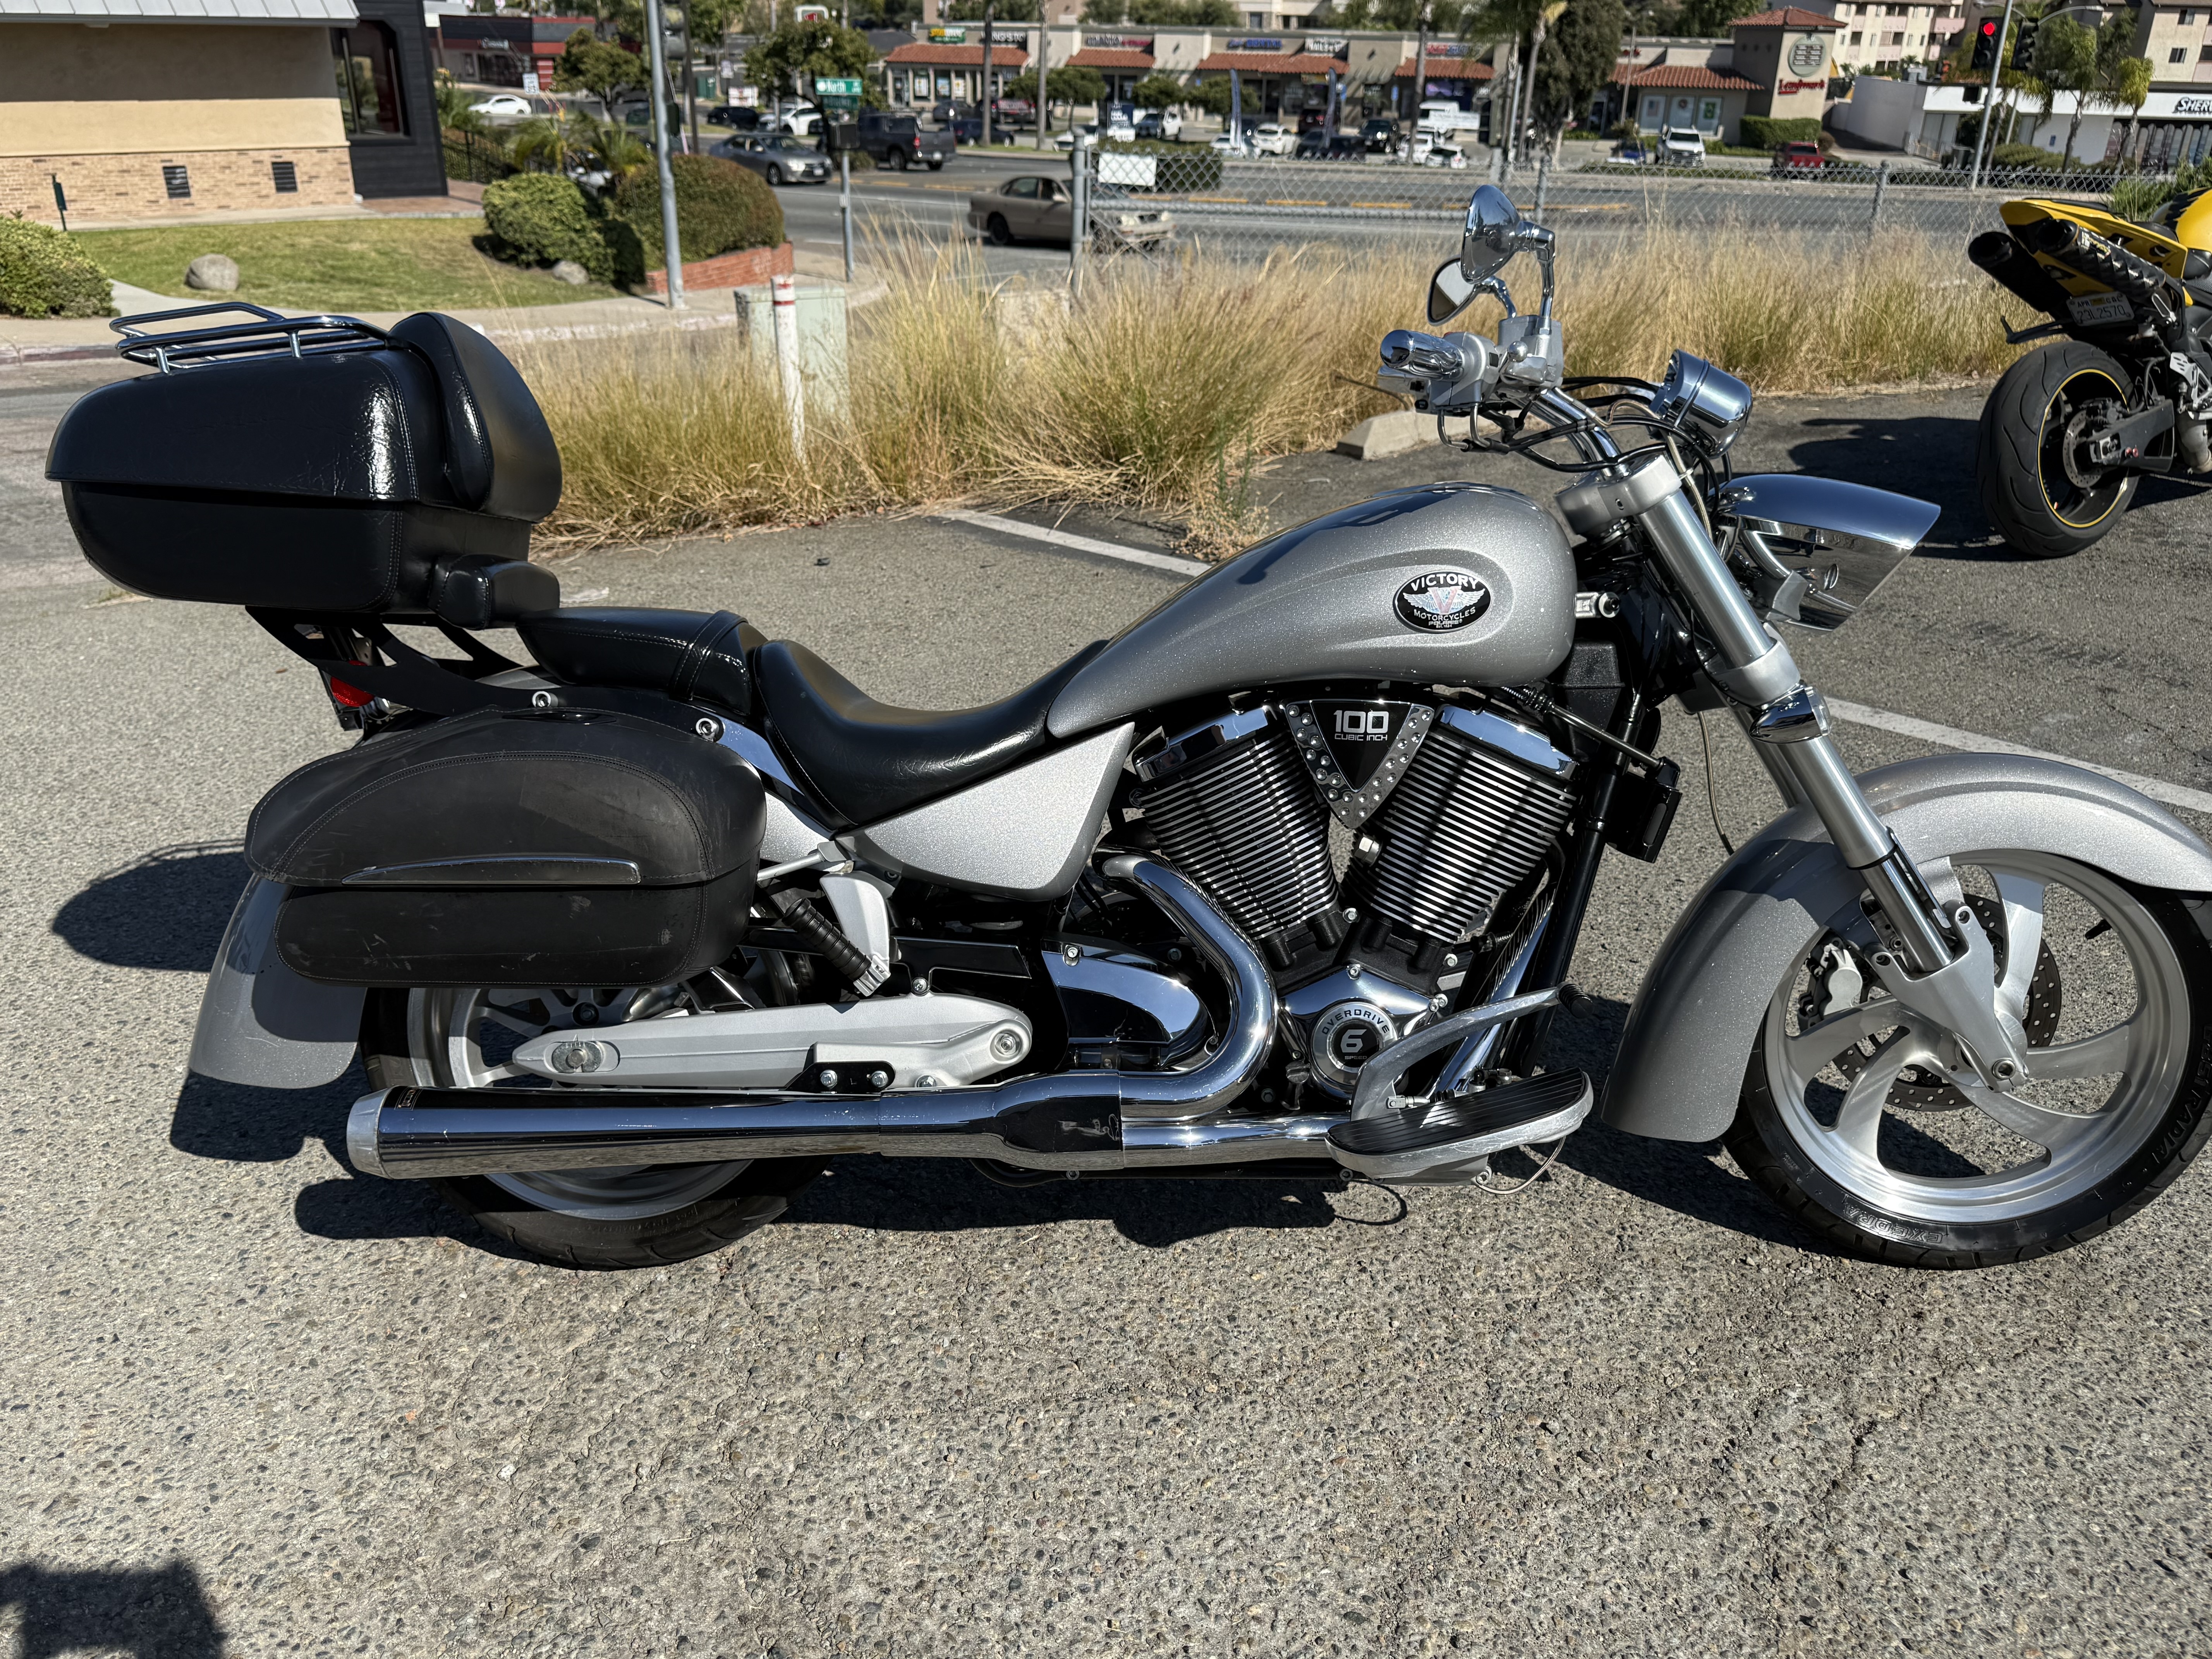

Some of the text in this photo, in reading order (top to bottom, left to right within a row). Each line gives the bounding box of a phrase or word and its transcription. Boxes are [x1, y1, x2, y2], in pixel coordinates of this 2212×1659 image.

[1411, 574, 1479, 591] VICTORY
[1414, 607, 1475, 620] MOTORCYCLES
[1333, 710, 1389, 733] 100
[1322, 1009, 1389, 1034] OVERDRIVE
[1340, 1029, 1367, 1053] 6
[2149, 1089, 2202, 1164] RADIAL
[1844, 1202, 1943, 1243] EXEDRA
